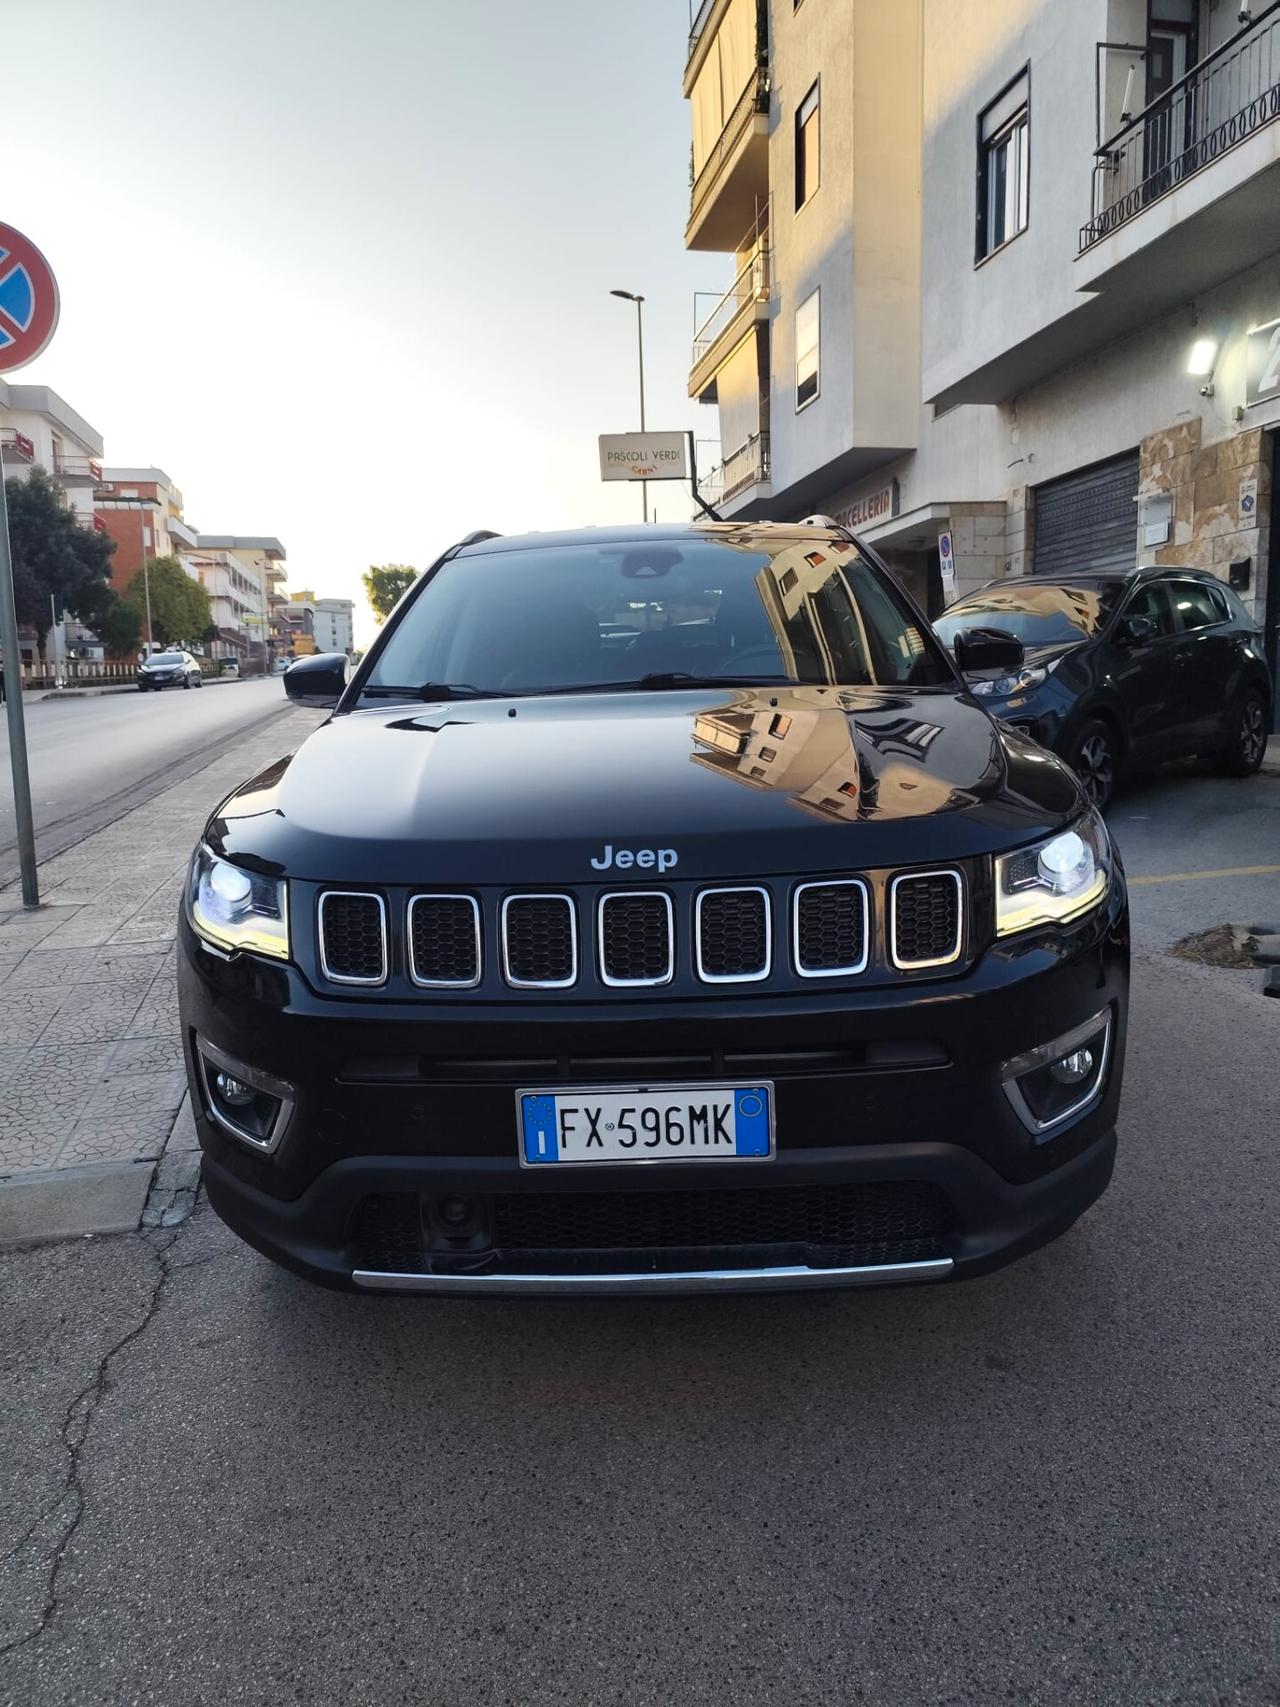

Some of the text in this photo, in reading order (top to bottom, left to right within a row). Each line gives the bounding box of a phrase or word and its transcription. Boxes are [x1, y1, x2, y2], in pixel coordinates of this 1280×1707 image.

[607, 449, 681, 462] PASCOLI VERDI
[591, 845, 678, 873] Jeep
[538, 1131, 546, 1154] I
